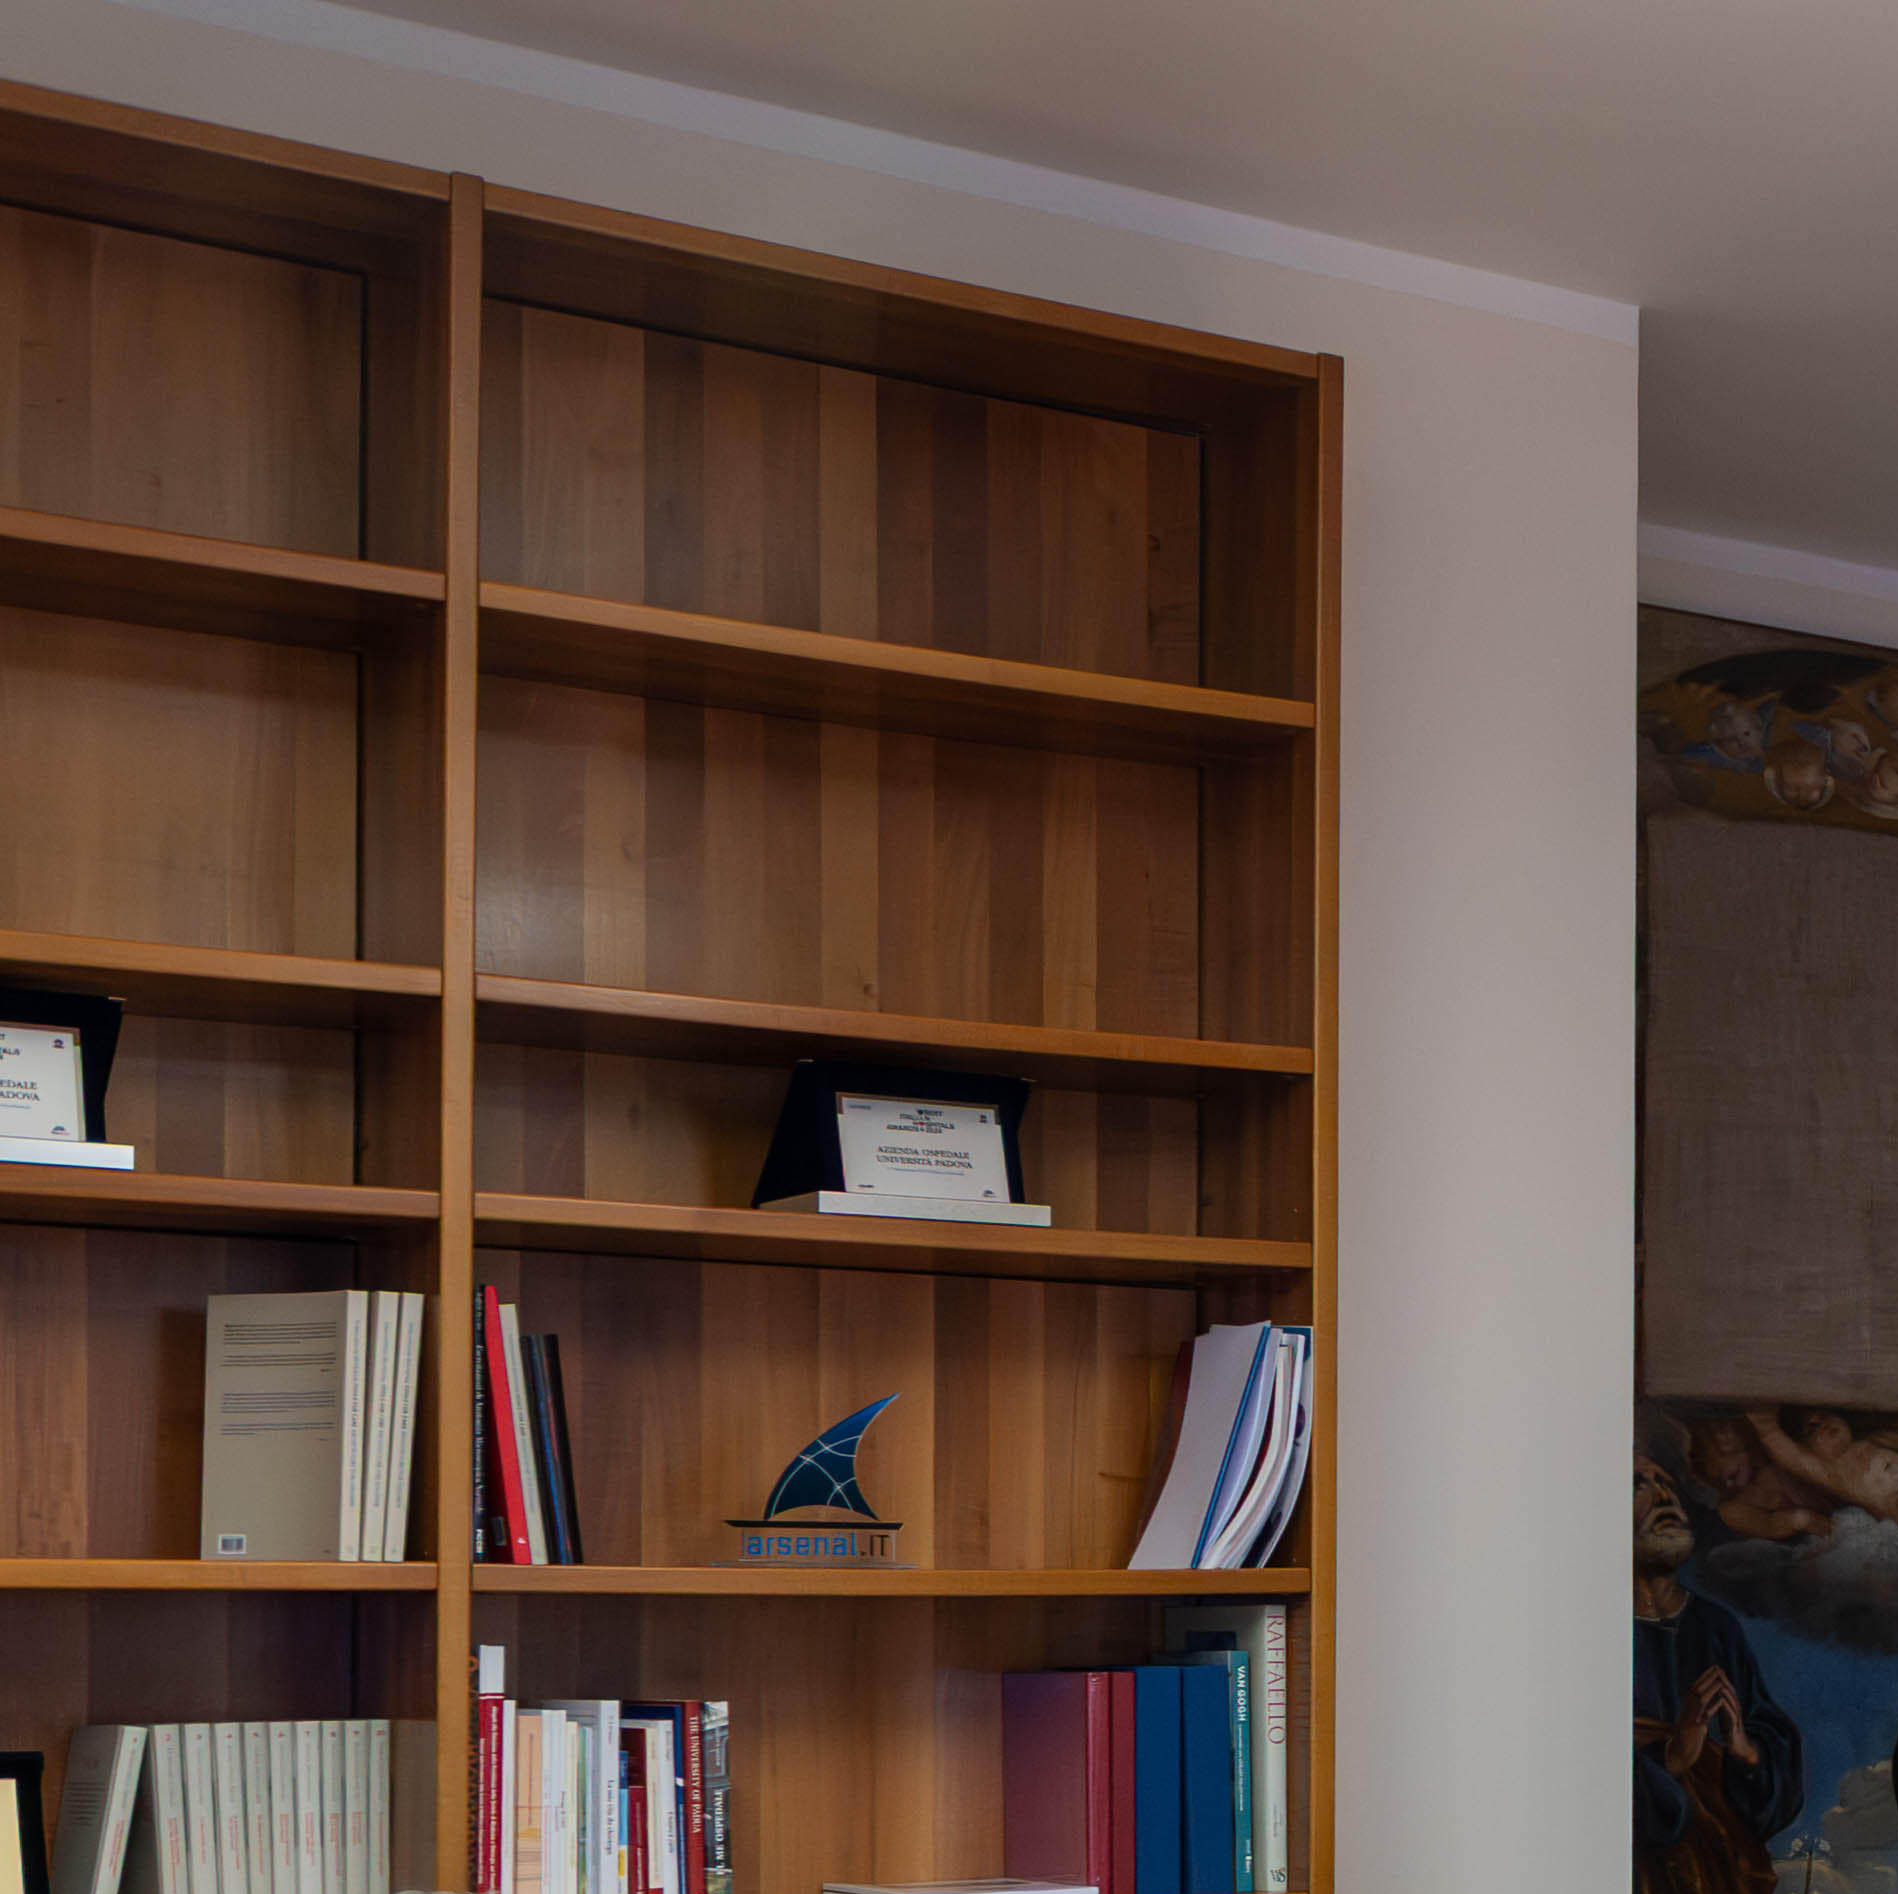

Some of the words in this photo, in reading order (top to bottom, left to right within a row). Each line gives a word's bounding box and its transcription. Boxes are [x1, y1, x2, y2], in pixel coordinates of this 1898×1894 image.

[921, 1149, 970, 1159] OSPEDALE
[1236, 1664, 1247, 1688] VAN
[1266, 1614, 1286, 1745] RAFFAELLO
[1236, 1689, 1247, 1722] GOGH
[689, 1715, 700, 1733] THE
[689, 1735, 702, 1787] UNIVERSITY
[691, 1789, 702, 1801] OF
[691, 1804, 702, 1833] PADUA
